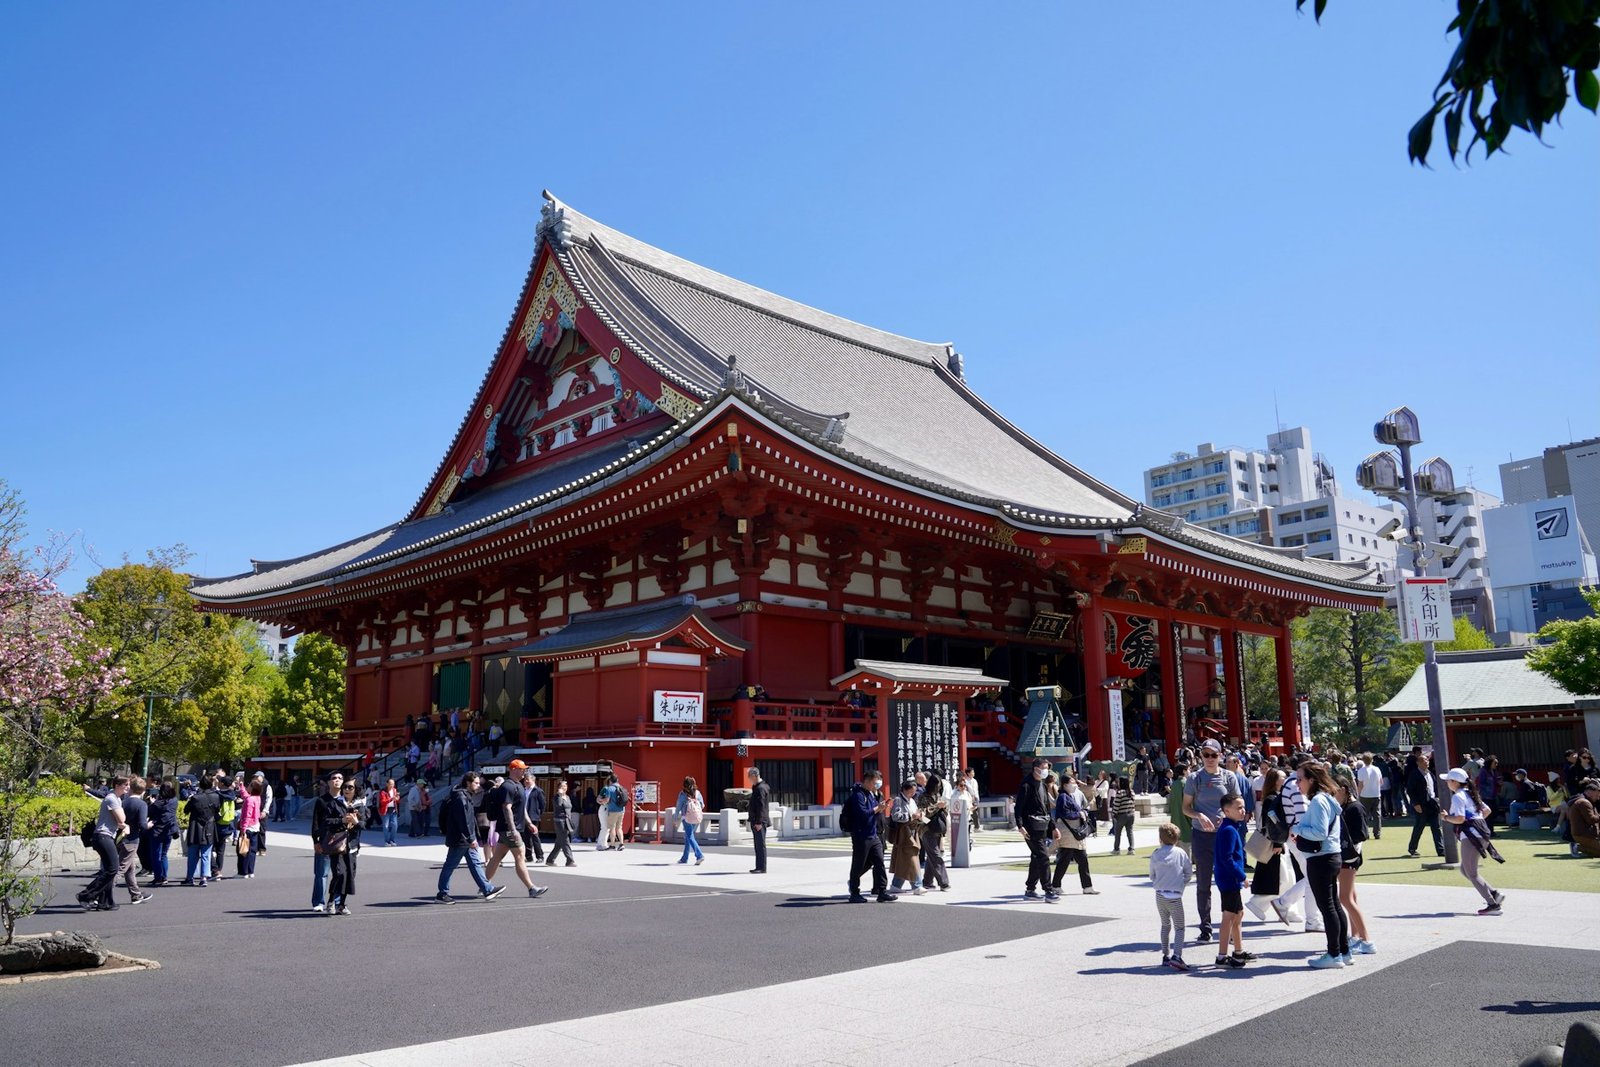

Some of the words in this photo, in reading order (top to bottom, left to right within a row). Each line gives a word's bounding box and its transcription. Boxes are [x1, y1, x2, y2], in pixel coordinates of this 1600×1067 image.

[1541, 560, 1577, 570] matsukiyo
[1421, 585, 1440, 639] 朱印所
[660, 699, 698, 718] 朱印所
